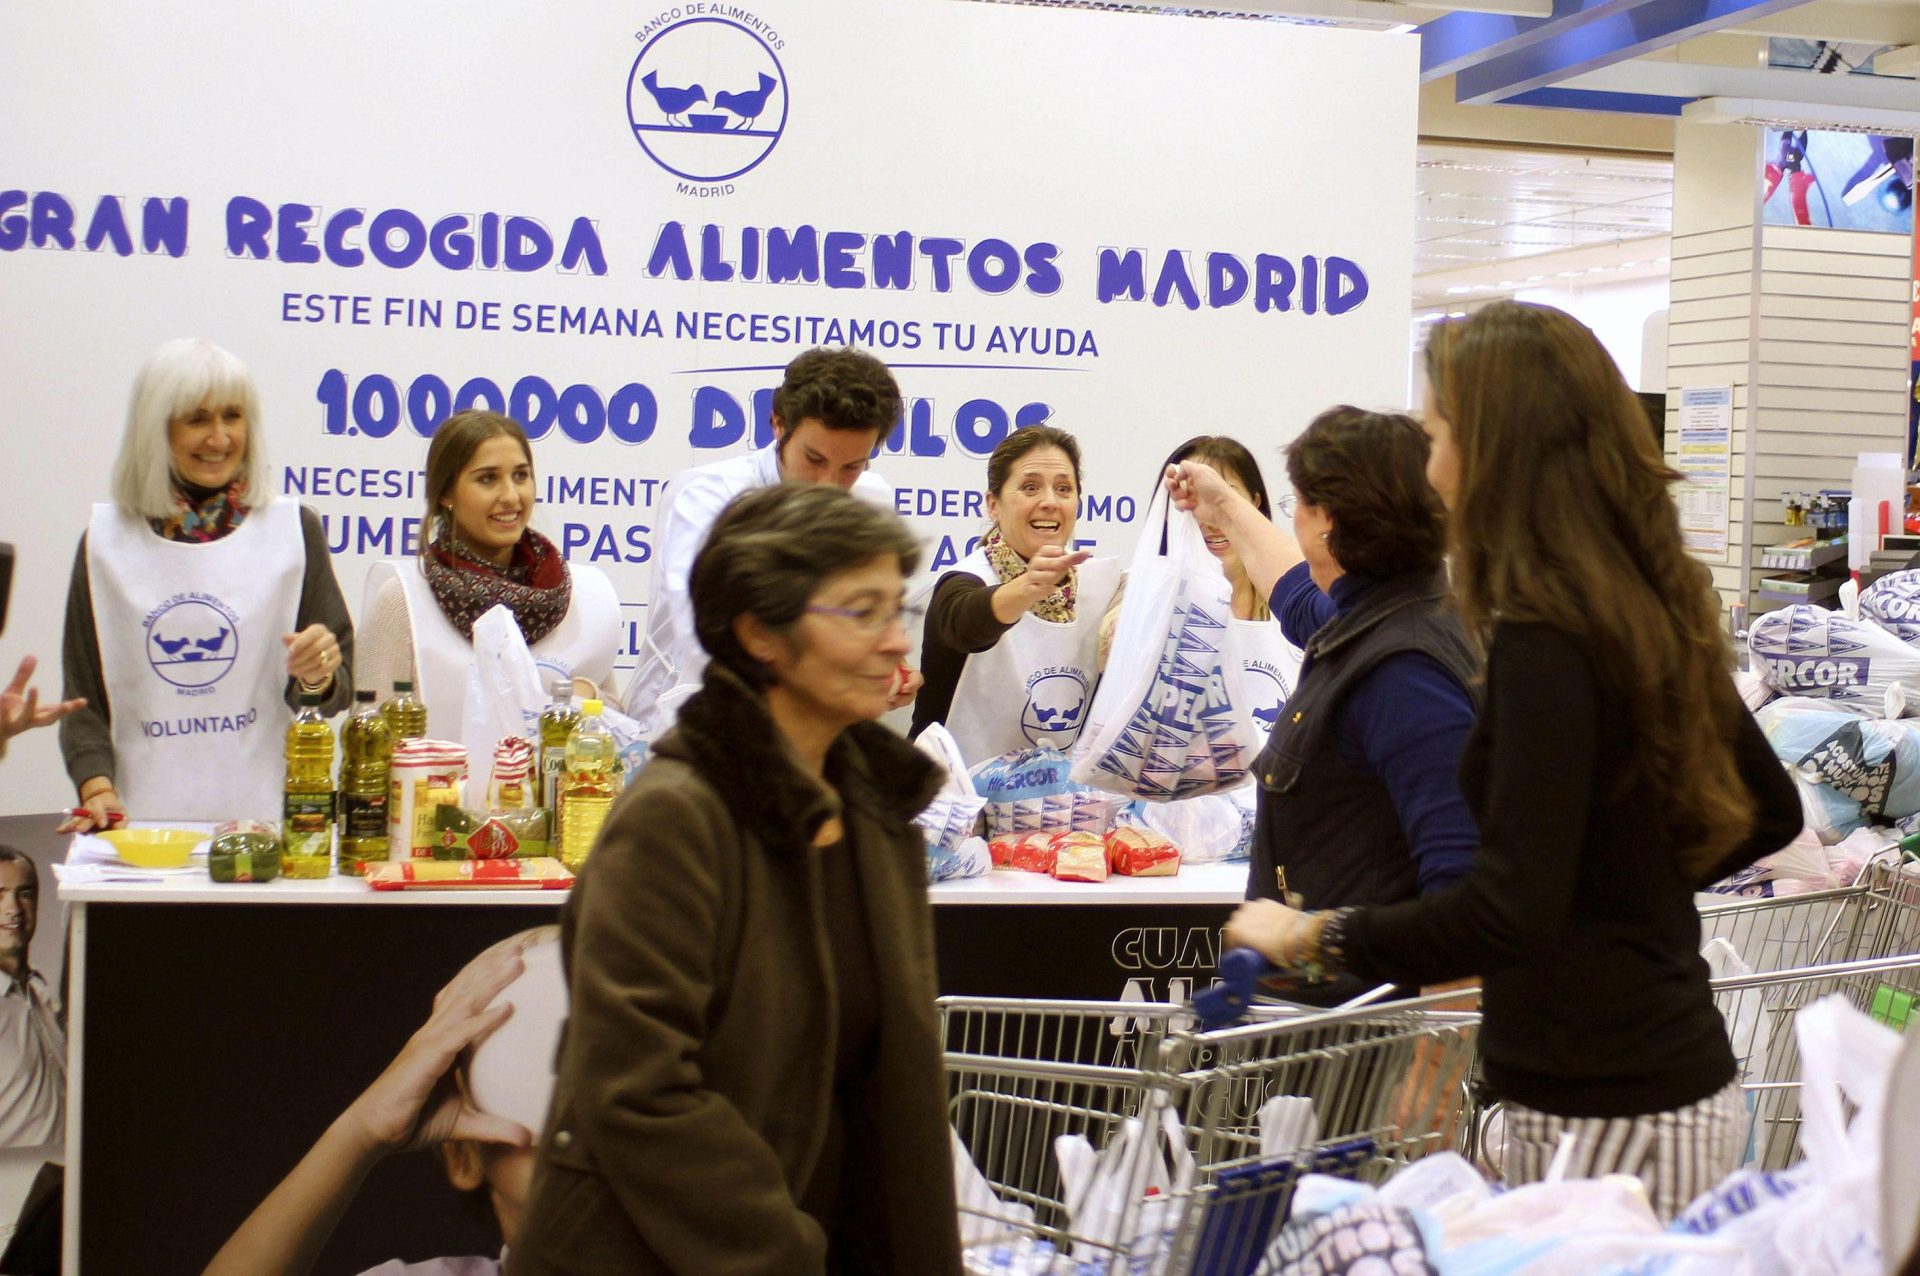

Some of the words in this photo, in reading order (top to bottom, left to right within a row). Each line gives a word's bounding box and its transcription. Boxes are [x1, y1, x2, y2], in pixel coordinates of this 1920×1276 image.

[634, 7, 682, 43] BANCO
[686, 3, 706, 15] DE
[710, 3, 785, 51] ALIMENTOS
[676, 183, 735, 198] MADRID
[0, 189, 189, 257] GRAN
[226, 196, 608, 279] RECOGIDA
[642, 221, 1064, 295] ALIMENTOS
[1097, 246, 1370, 315] MADRID
[282, 293, 371, 325] ESTE
[385, 298, 442, 328] FIN
[456, 301, 501, 331] DE
[512, 304, 664, 337] SEMANA
[676, 311, 921, 349] NECESITAMOS
[933, 323, 976, 352] TU
[986, 326, 1099, 357] AYUDA
[562, 522, 652, 564] PAS
[172, 592, 186, 604] DE
[1043, 666, 1057, 676] DE
[176, 686, 216, 697] MADRID
